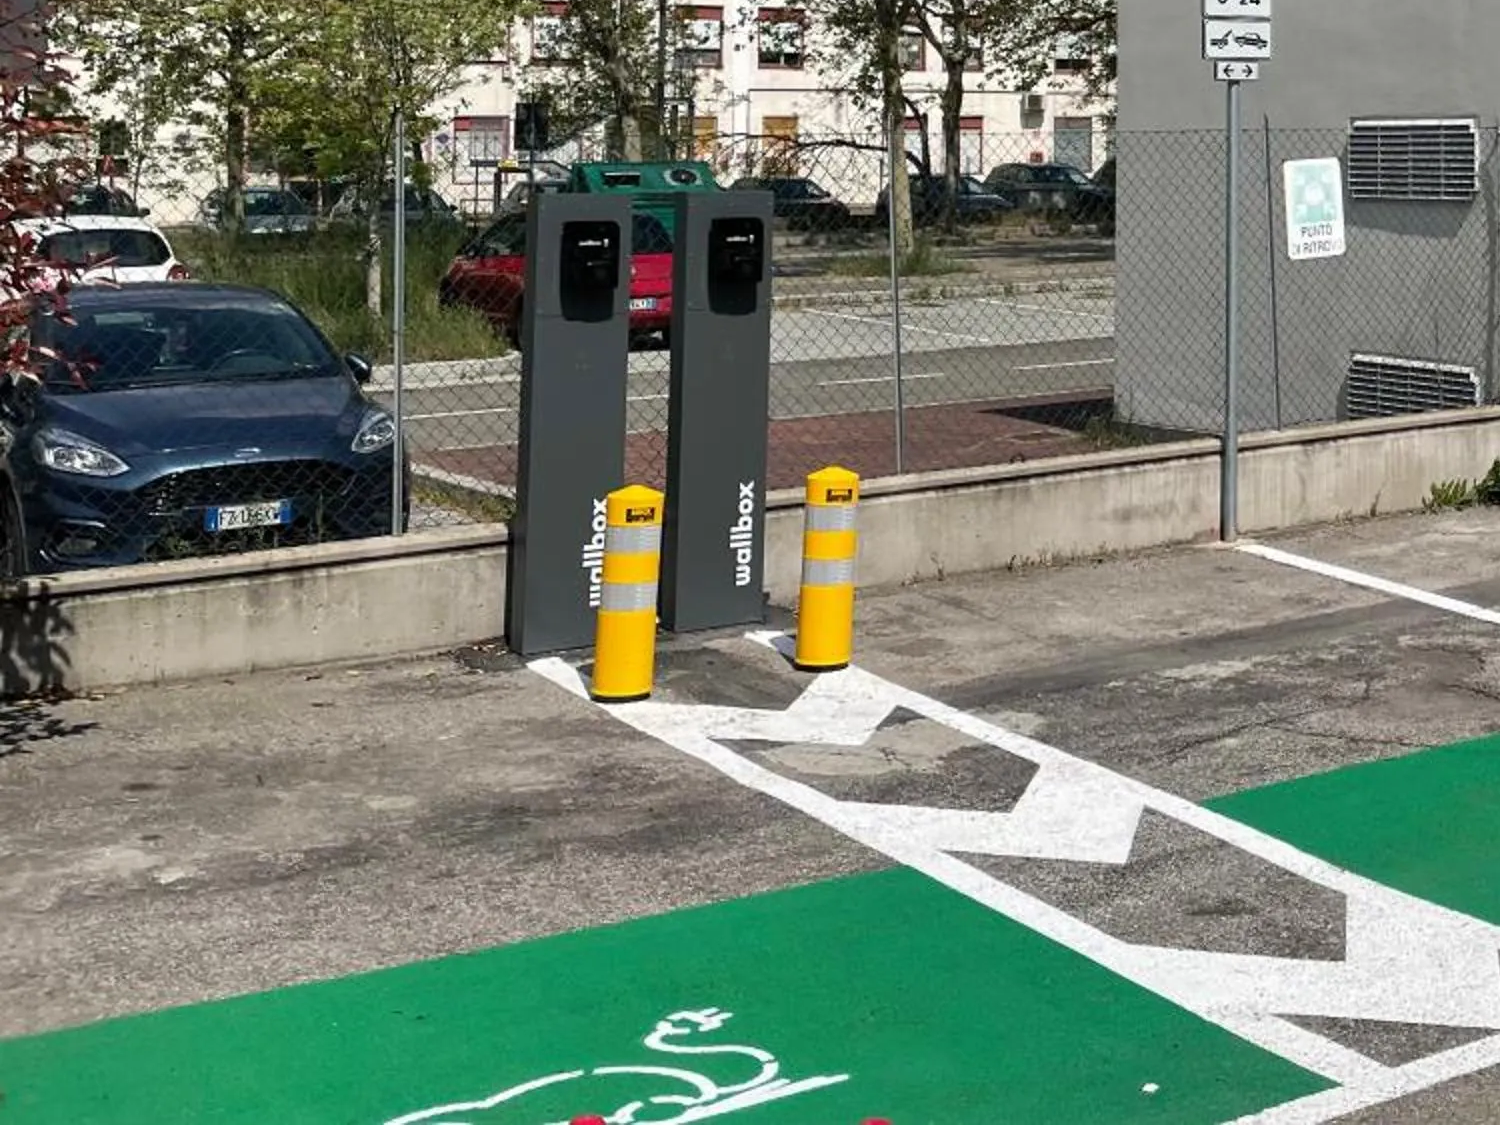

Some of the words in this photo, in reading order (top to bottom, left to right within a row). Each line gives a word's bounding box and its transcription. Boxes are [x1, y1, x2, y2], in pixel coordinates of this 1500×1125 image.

[1301, 223, 1333, 238] PUNTO
[581, 498, 608, 607] wallbox
[729, 480, 755, 586] wallbox
